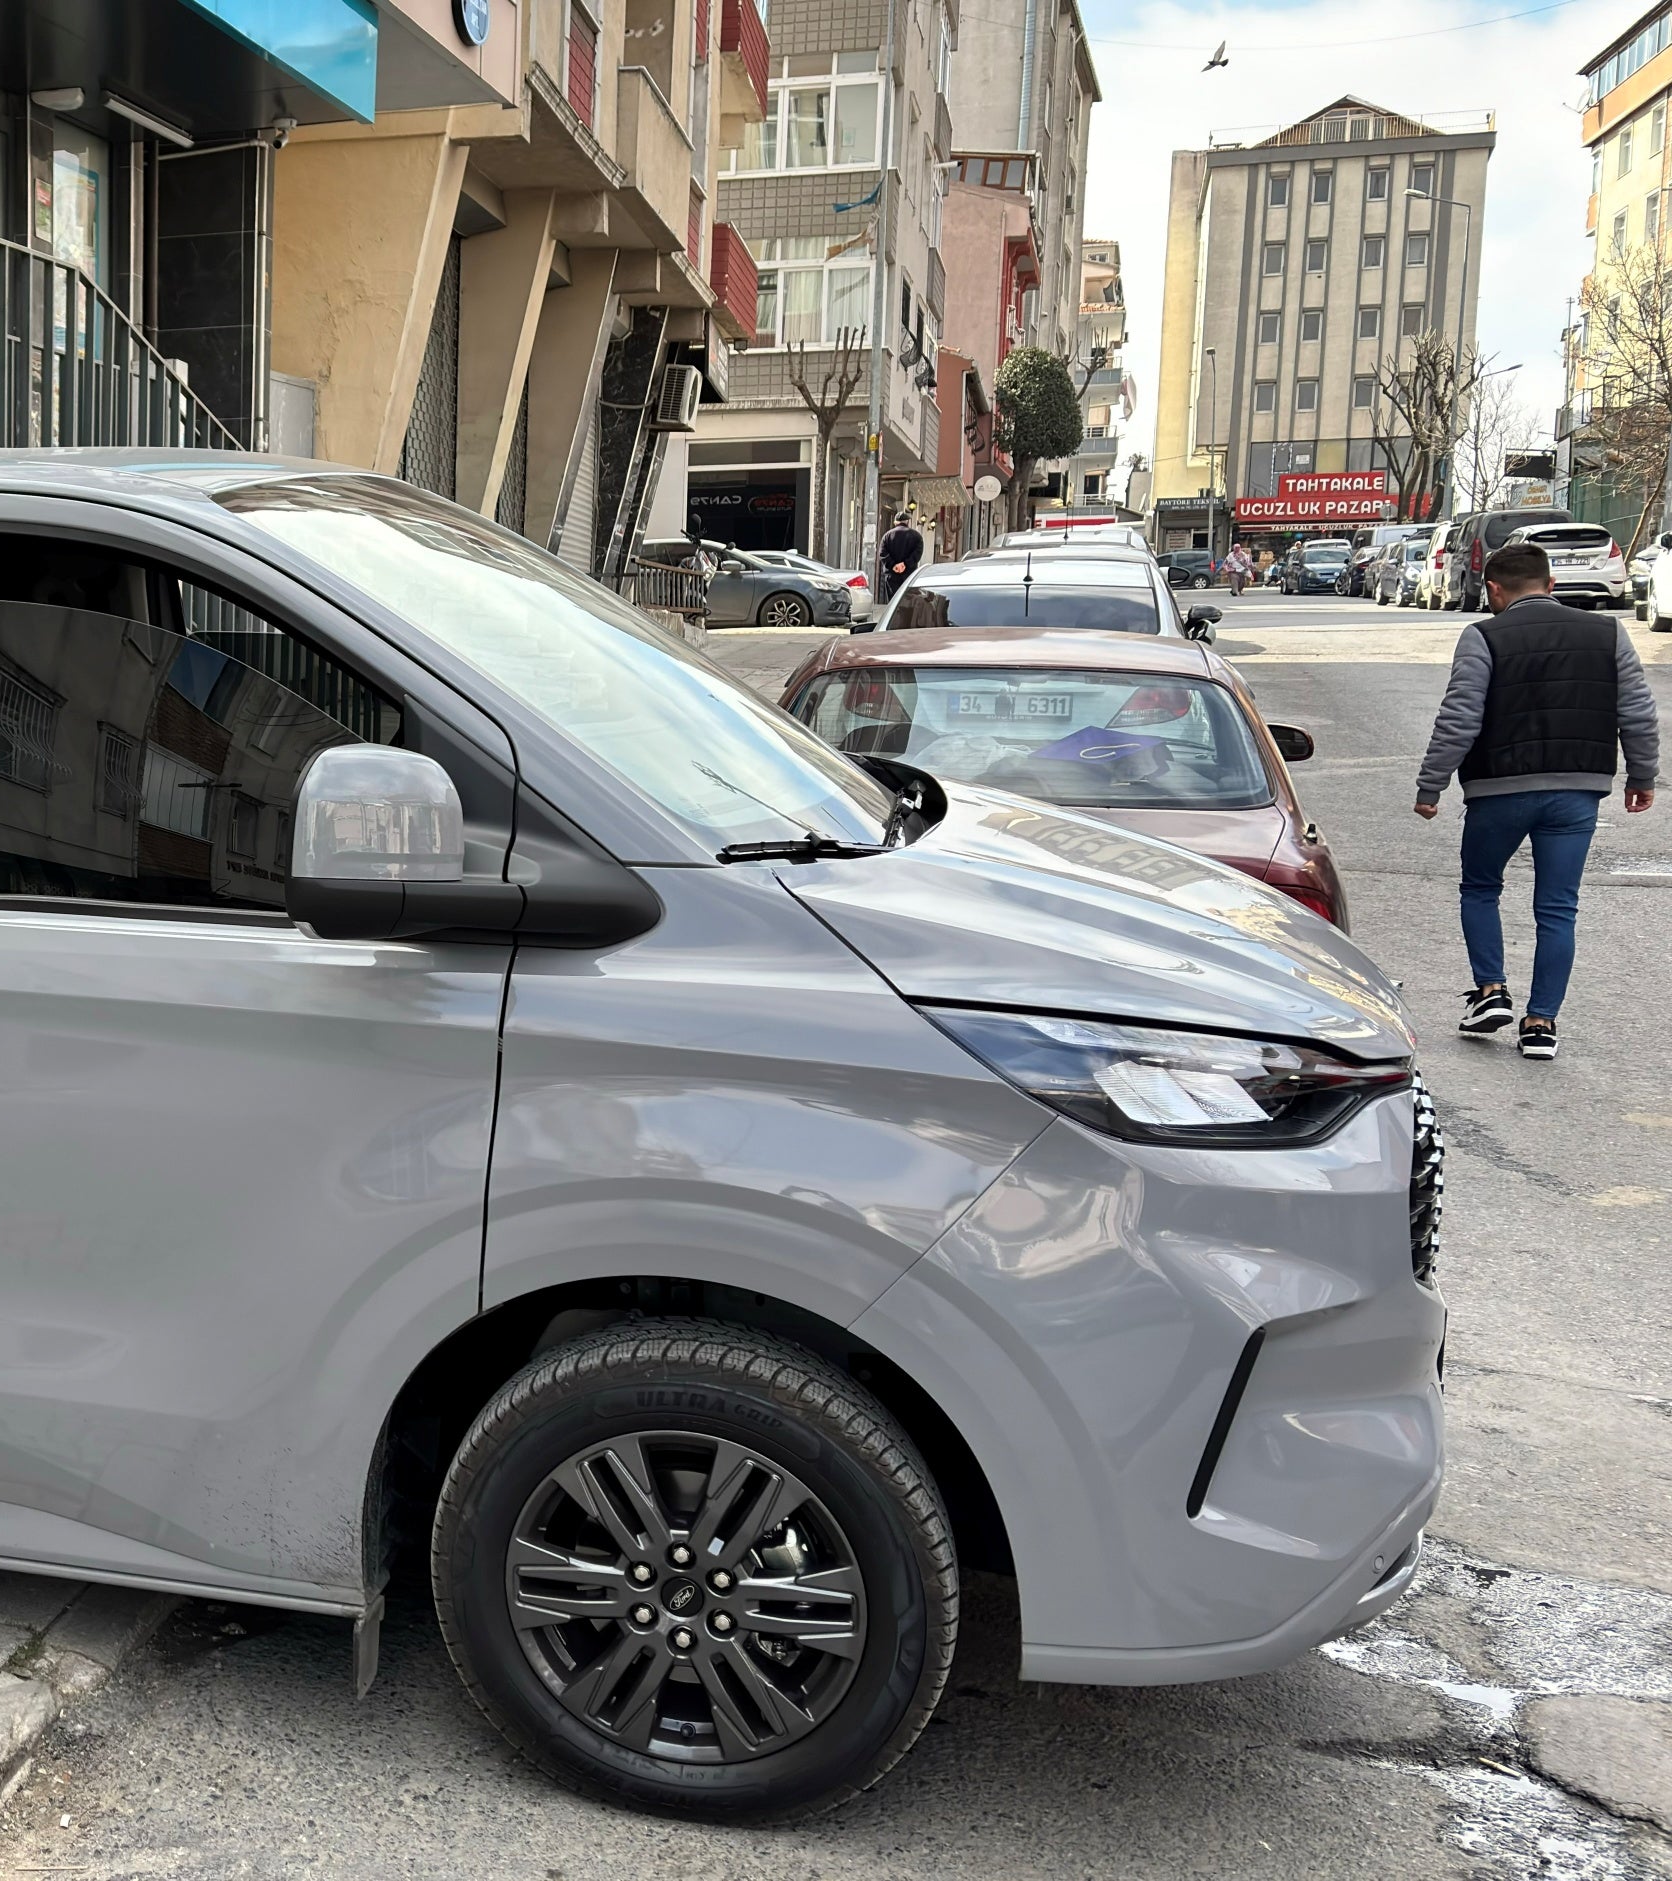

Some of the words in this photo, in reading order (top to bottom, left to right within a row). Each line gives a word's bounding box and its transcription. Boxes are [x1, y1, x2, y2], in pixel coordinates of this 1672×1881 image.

[1285, 476, 1384, 493] TAHTAKALE
[960, 695, 982, 712] 34
[1027, 696, 1066, 715] 6311
[636, 1390, 726, 1413] ULTRA
[734, 1404, 783, 1428] GRIP
